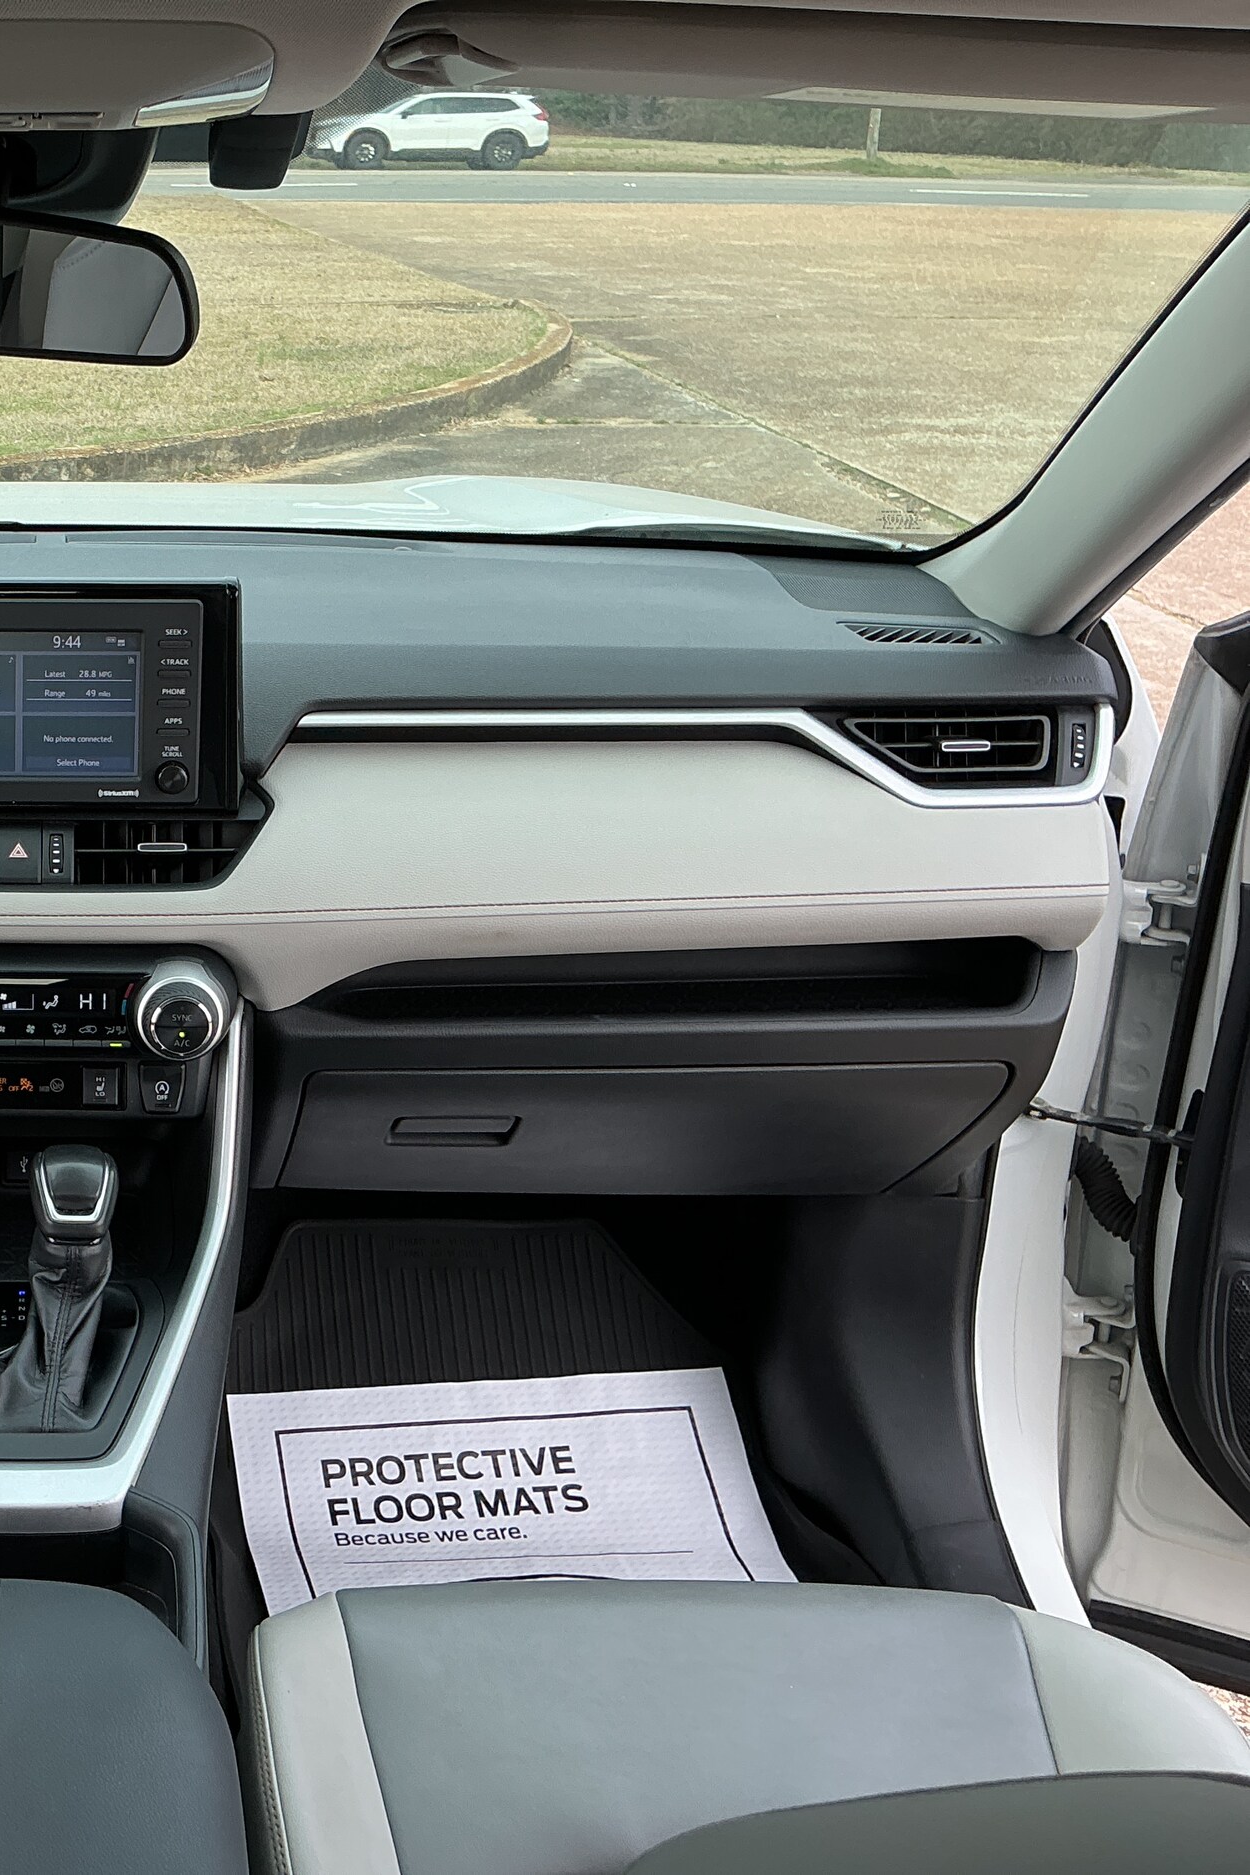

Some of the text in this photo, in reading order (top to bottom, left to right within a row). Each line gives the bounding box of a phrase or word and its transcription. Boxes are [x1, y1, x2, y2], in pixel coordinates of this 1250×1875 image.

[165, 628, 182, 636] SEEK
[52, 635, 81, 649] 9:44
[166, 658, 189, 666] TRACK
[44, 670, 66, 678] Latest
[78, 670, 97, 678] 28.8
[44, 689, 66, 698] Range
[85, 689, 97, 697] 49
[164, 717, 183, 725] APPS
[43, 735, 114, 744] No phone connected.
[56, 758, 100, 767] Select Phone
[171, 1014, 193, 1022] SYNC
[173, 1039, 191, 1048] A/C
[320, 1445, 577, 1489] PROTECTIVE
[327, 1483, 590, 1528] FLOOR MATS
[334, 1526, 528, 1548] Because we care.
